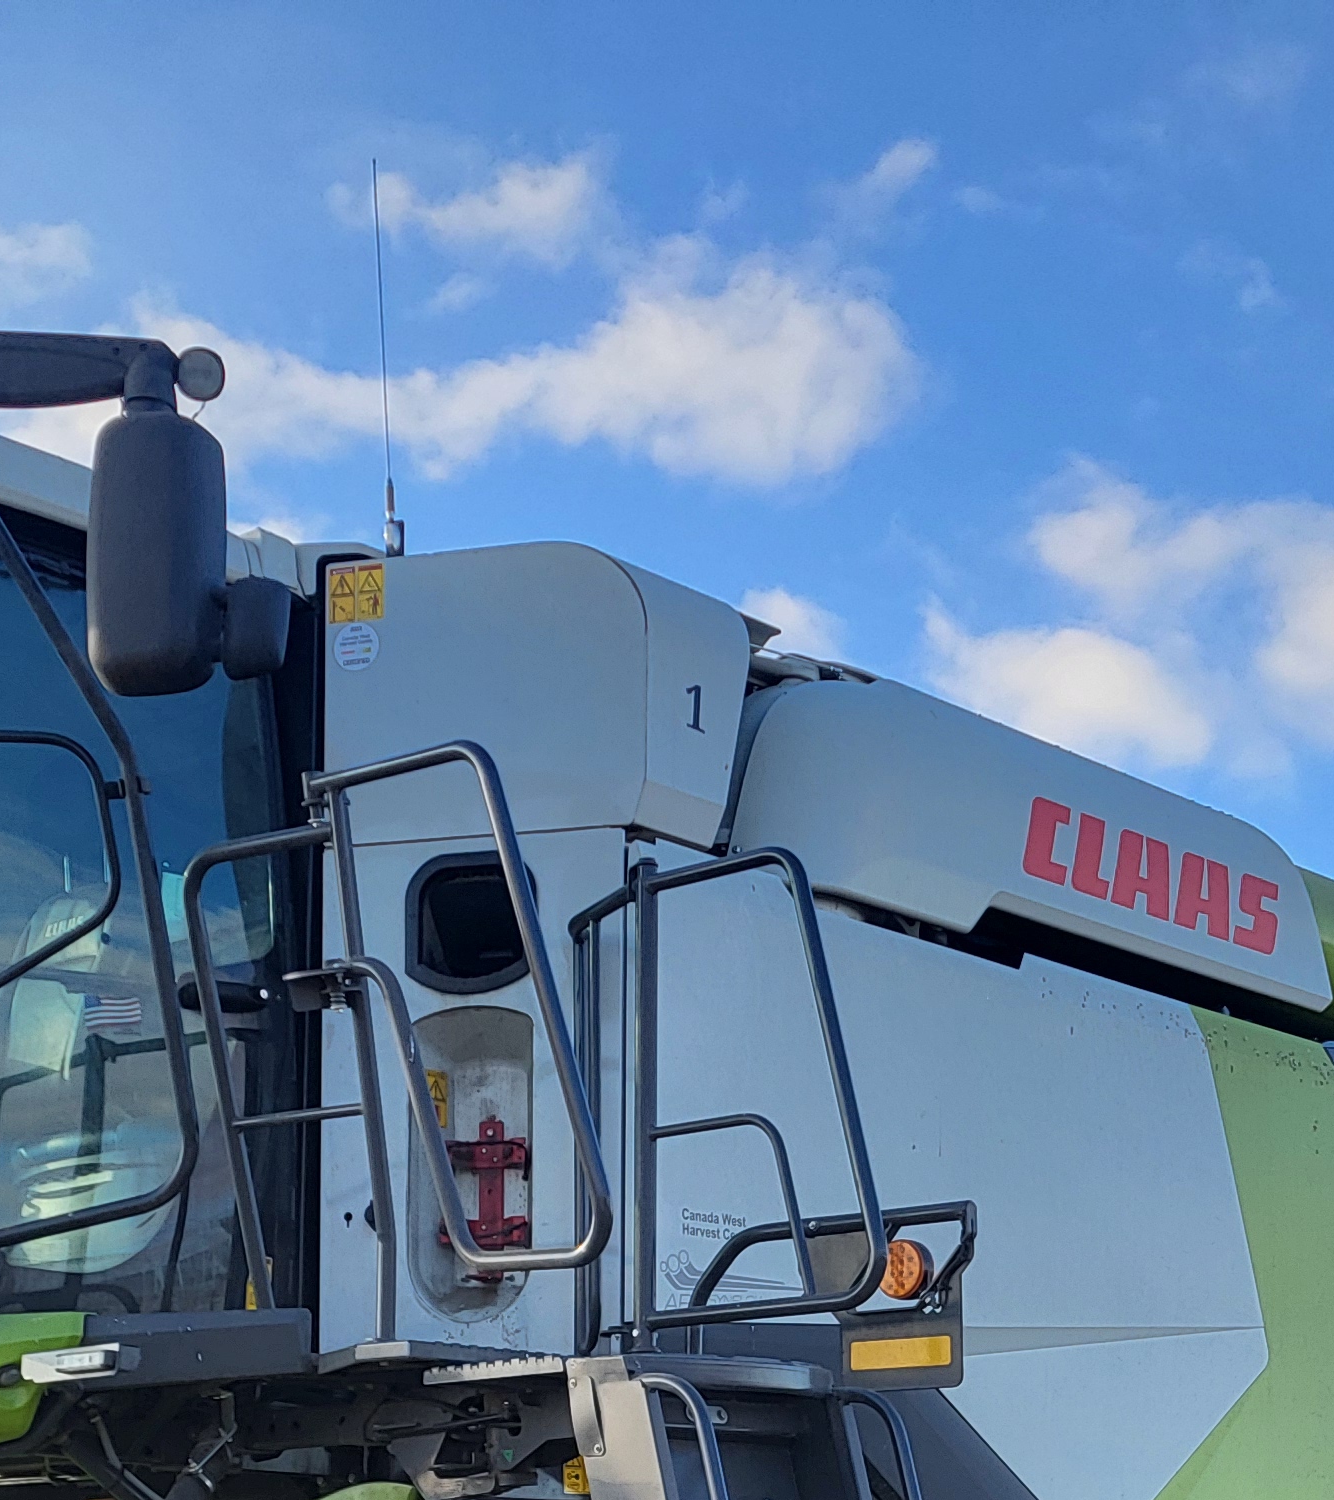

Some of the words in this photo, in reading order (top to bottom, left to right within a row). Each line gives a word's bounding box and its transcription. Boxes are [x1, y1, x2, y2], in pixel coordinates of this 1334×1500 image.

[685, 684, 705, 734] 1
[1023, 797, 1280, 956] CLAAS
[681, 1207, 720, 1225] Canada
[721, 1212, 747, 1228] West
[681, 1222, 721, 1240] Harvest
